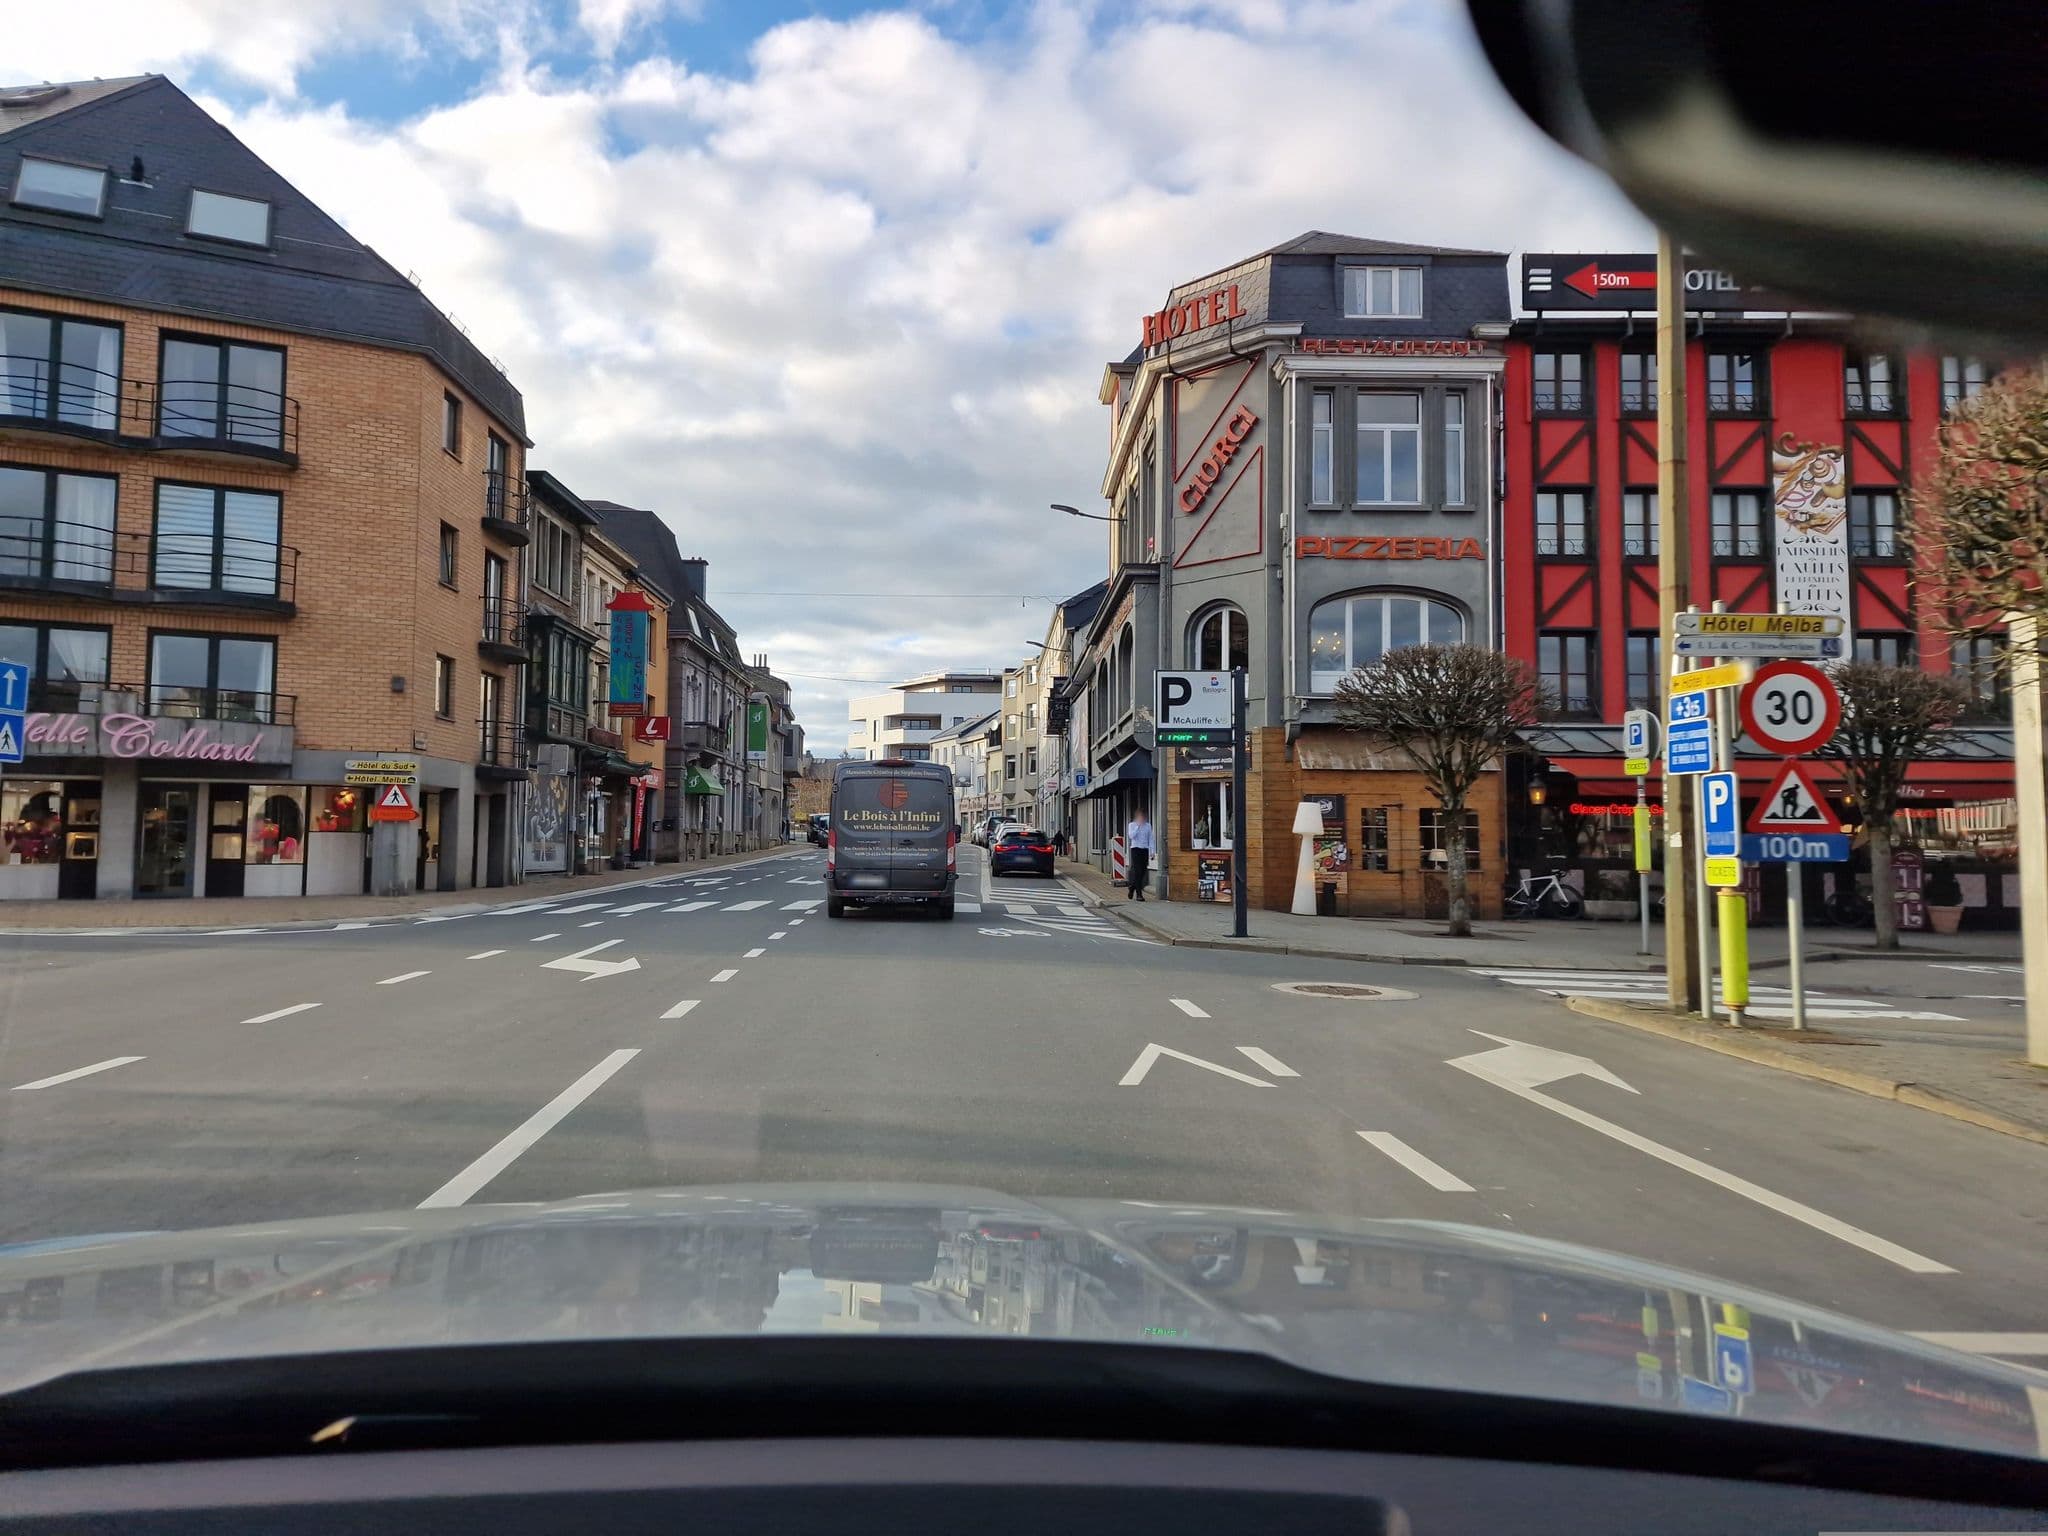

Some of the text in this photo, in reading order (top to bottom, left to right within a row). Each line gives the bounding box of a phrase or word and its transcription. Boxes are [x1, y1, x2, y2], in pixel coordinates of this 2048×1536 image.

[1591, 273, 1630, 287] 150m
[1683, 269, 1741, 292] OTEL
[1142, 284, 1247, 349] HOTEL
[1302, 338, 1487, 357] RESTAURANT
[1296, 536, 1486, 561] PIZZERIA
[1703, 616, 1823, 633] Hôtel Melba
[1202, 686, 1228, 694] Bastogne
[1161, 677, 1192, 724] P
[1766, 690, 1813, 726] 30
[1173, 716, 1212, 725] McAuliffe
[102, 712, 264, 763] Collard
[1631, 725, 1640, 744] P
[357, 761, 378, 769] Hôtel
[393, 762, 409, 770] Sud
[354, 774, 407, 784] Hôtel Melba
[1570, 803, 1607, 815] Glaces
[1708, 780, 1729, 823] P
[843, 810, 941, 822] Le Bois à l'Infini
[1759, 836, 1830, 859] 100m
